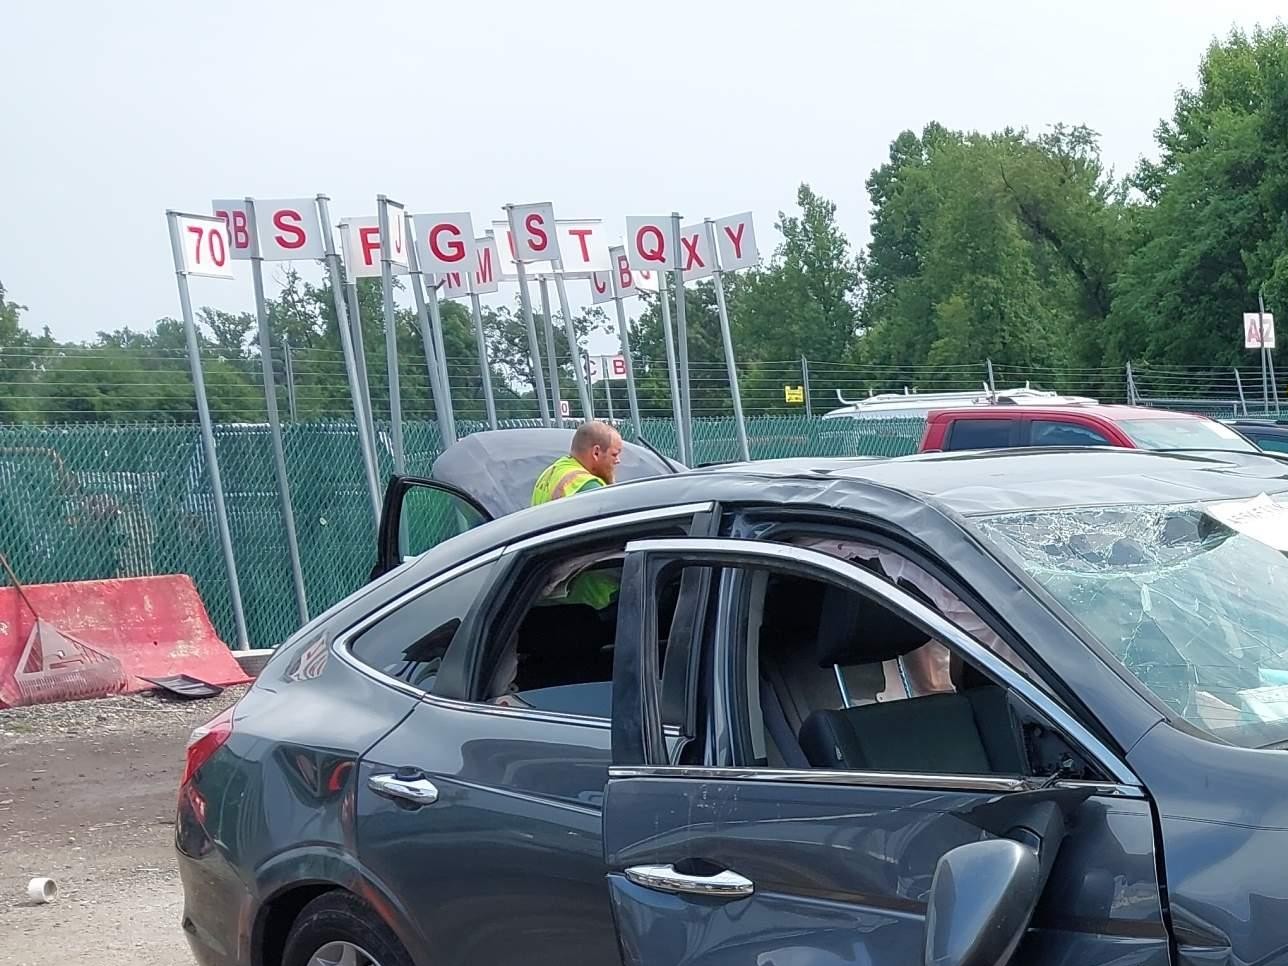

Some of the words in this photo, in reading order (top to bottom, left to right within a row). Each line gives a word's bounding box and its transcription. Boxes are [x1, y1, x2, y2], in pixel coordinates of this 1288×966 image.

[187, 225, 225, 267] 70
[273, 209, 306, 249] S
[359, 227, 381, 266] F
[429, 223, 466, 262] G
[525, 213, 548, 251] S
[636, 225, 667, 263] Q
[724, 223, 745, 259] Y
[476, 247, 493, 284] M
[681, 234, 705, 271] X
[617, 255, 633, 289] B
[612, 359, 627, 375] B
